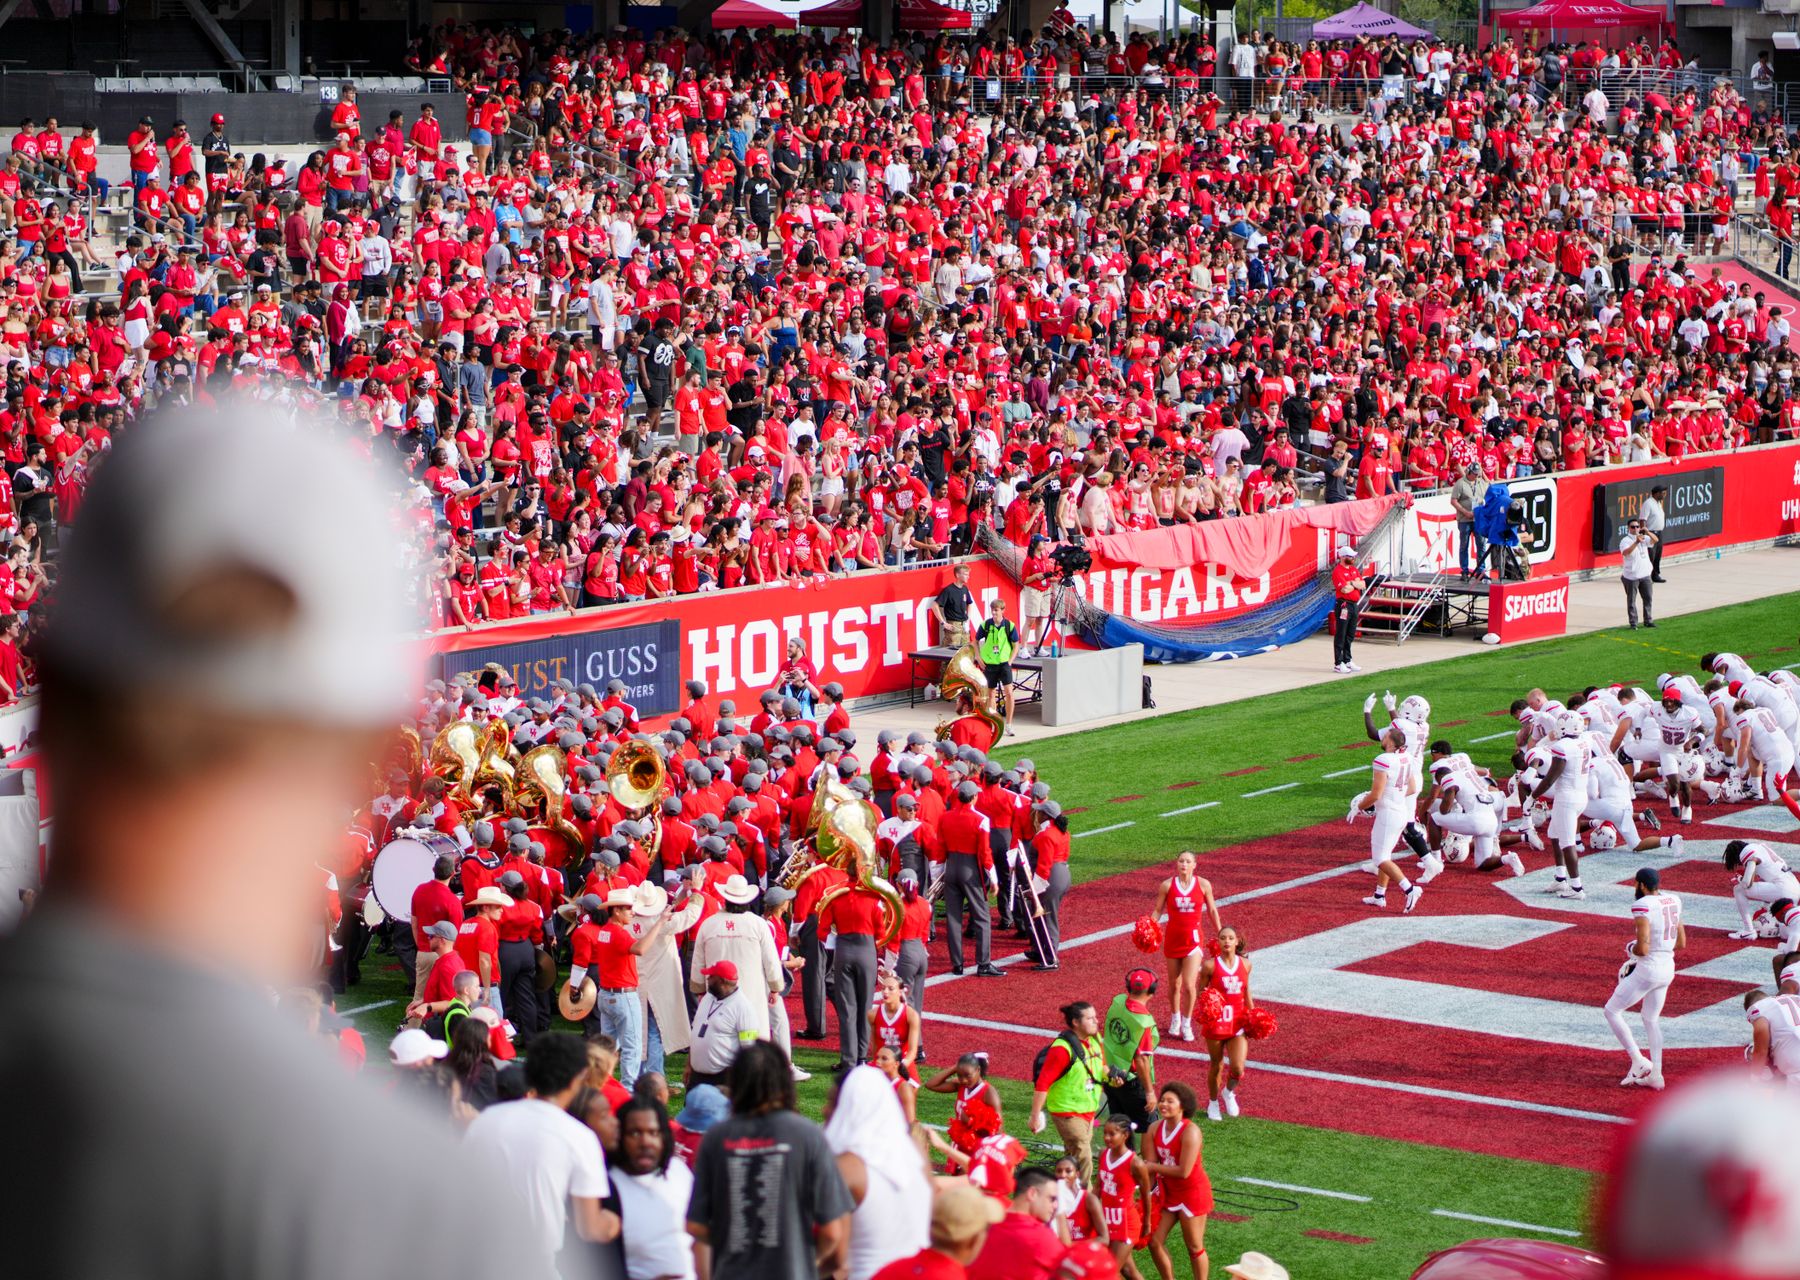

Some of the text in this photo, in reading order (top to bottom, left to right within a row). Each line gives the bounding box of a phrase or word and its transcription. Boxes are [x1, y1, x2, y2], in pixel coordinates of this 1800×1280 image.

[1569, 5, 1622, 14] TDECU
[1351, 18, 1396, 29] crumbl
[320, 86, 338, 99] 138
[1676, 482, 1713, 509] GUSS
[1666, 512, 1710, 527] INJURY LAWYERS
[1504, 586, 1567, 622] SEATGEEK
[586, 643, 658, 682] GUSS
[1661, 730, 1686, 746] 82
[1661, 905, 1679, 941] 15
